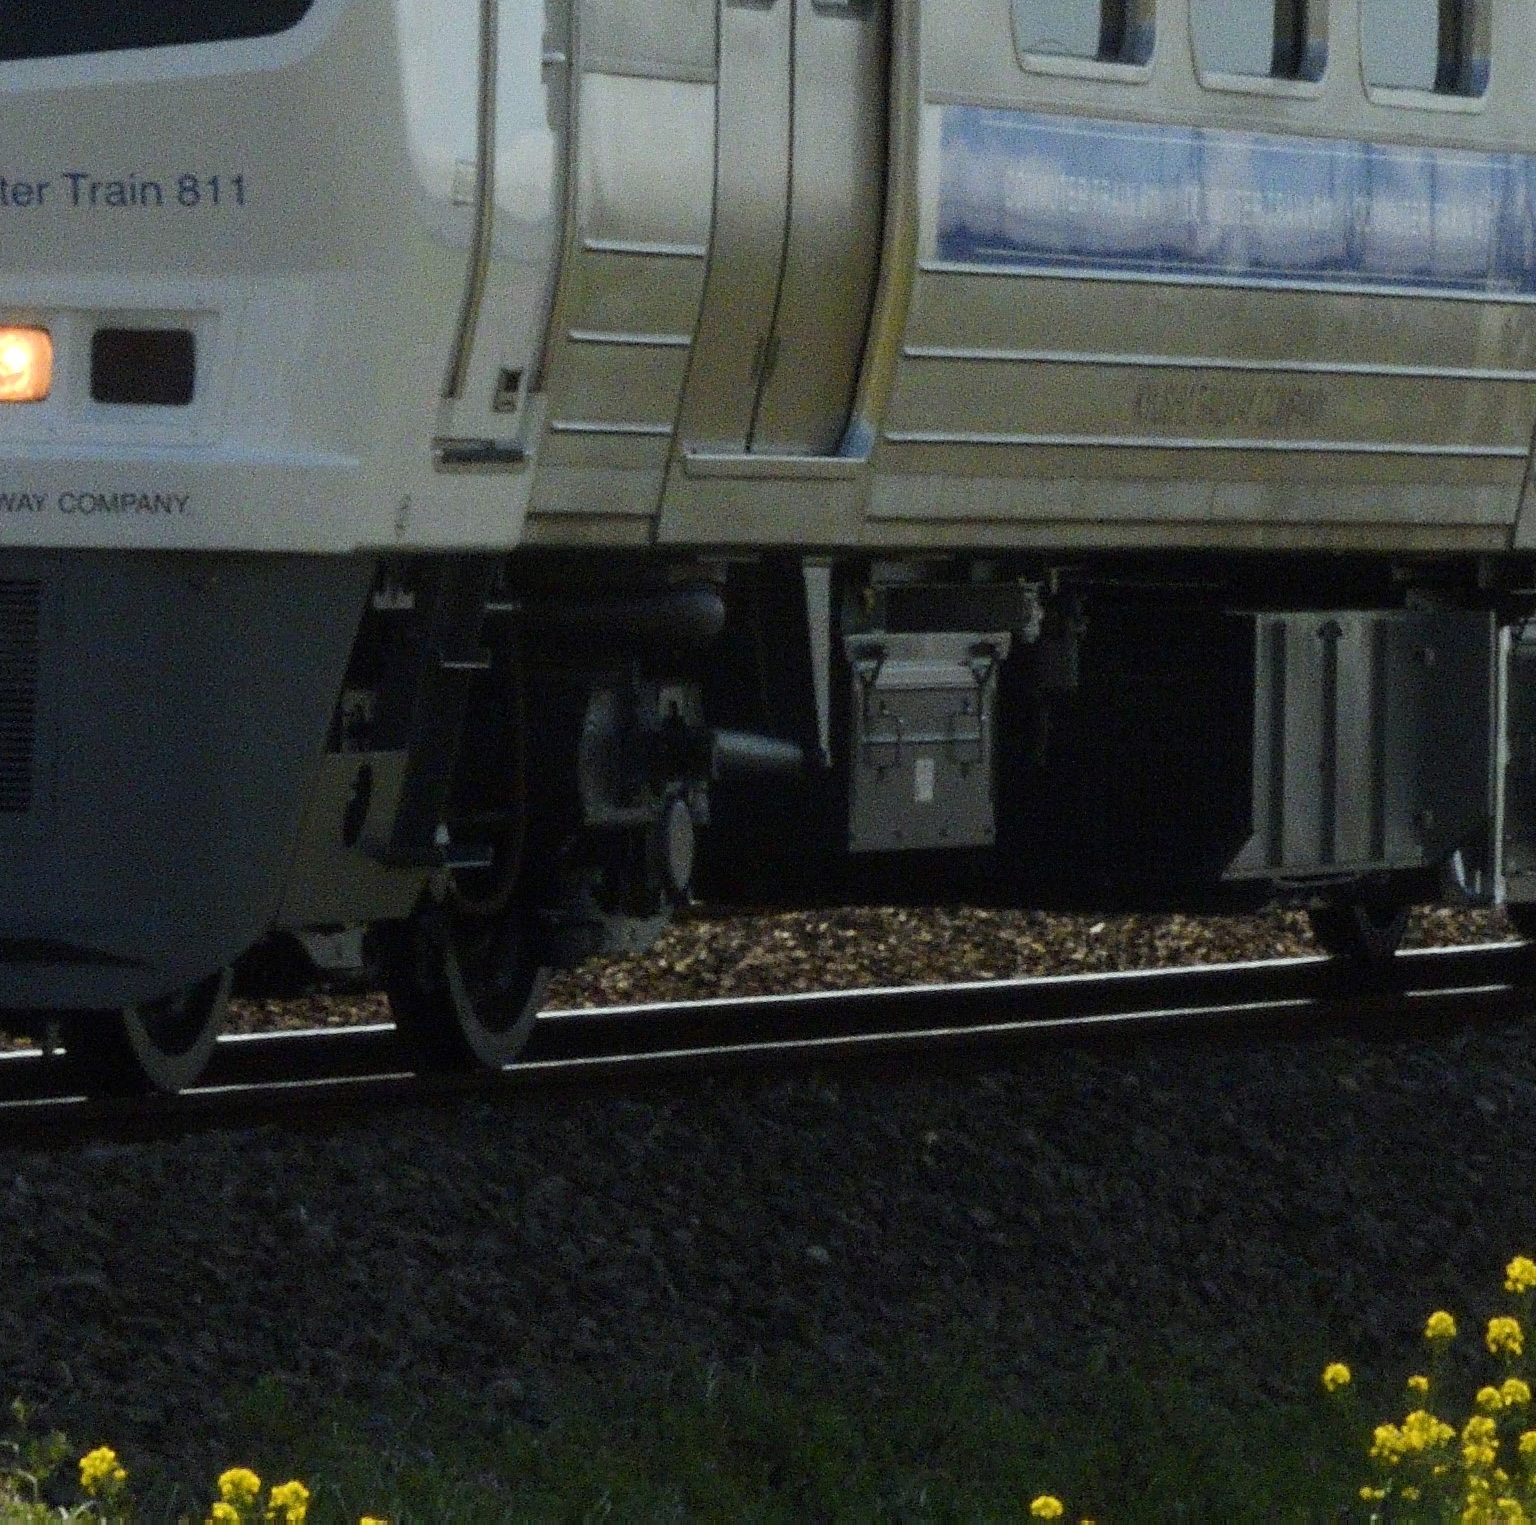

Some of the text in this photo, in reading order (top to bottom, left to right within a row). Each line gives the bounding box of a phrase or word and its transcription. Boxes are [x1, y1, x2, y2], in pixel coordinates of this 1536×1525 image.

[64, 172, 165, 209] Train
[177, 173, 248, 209] 811
[57, 491, 191, 516] COMPANY
